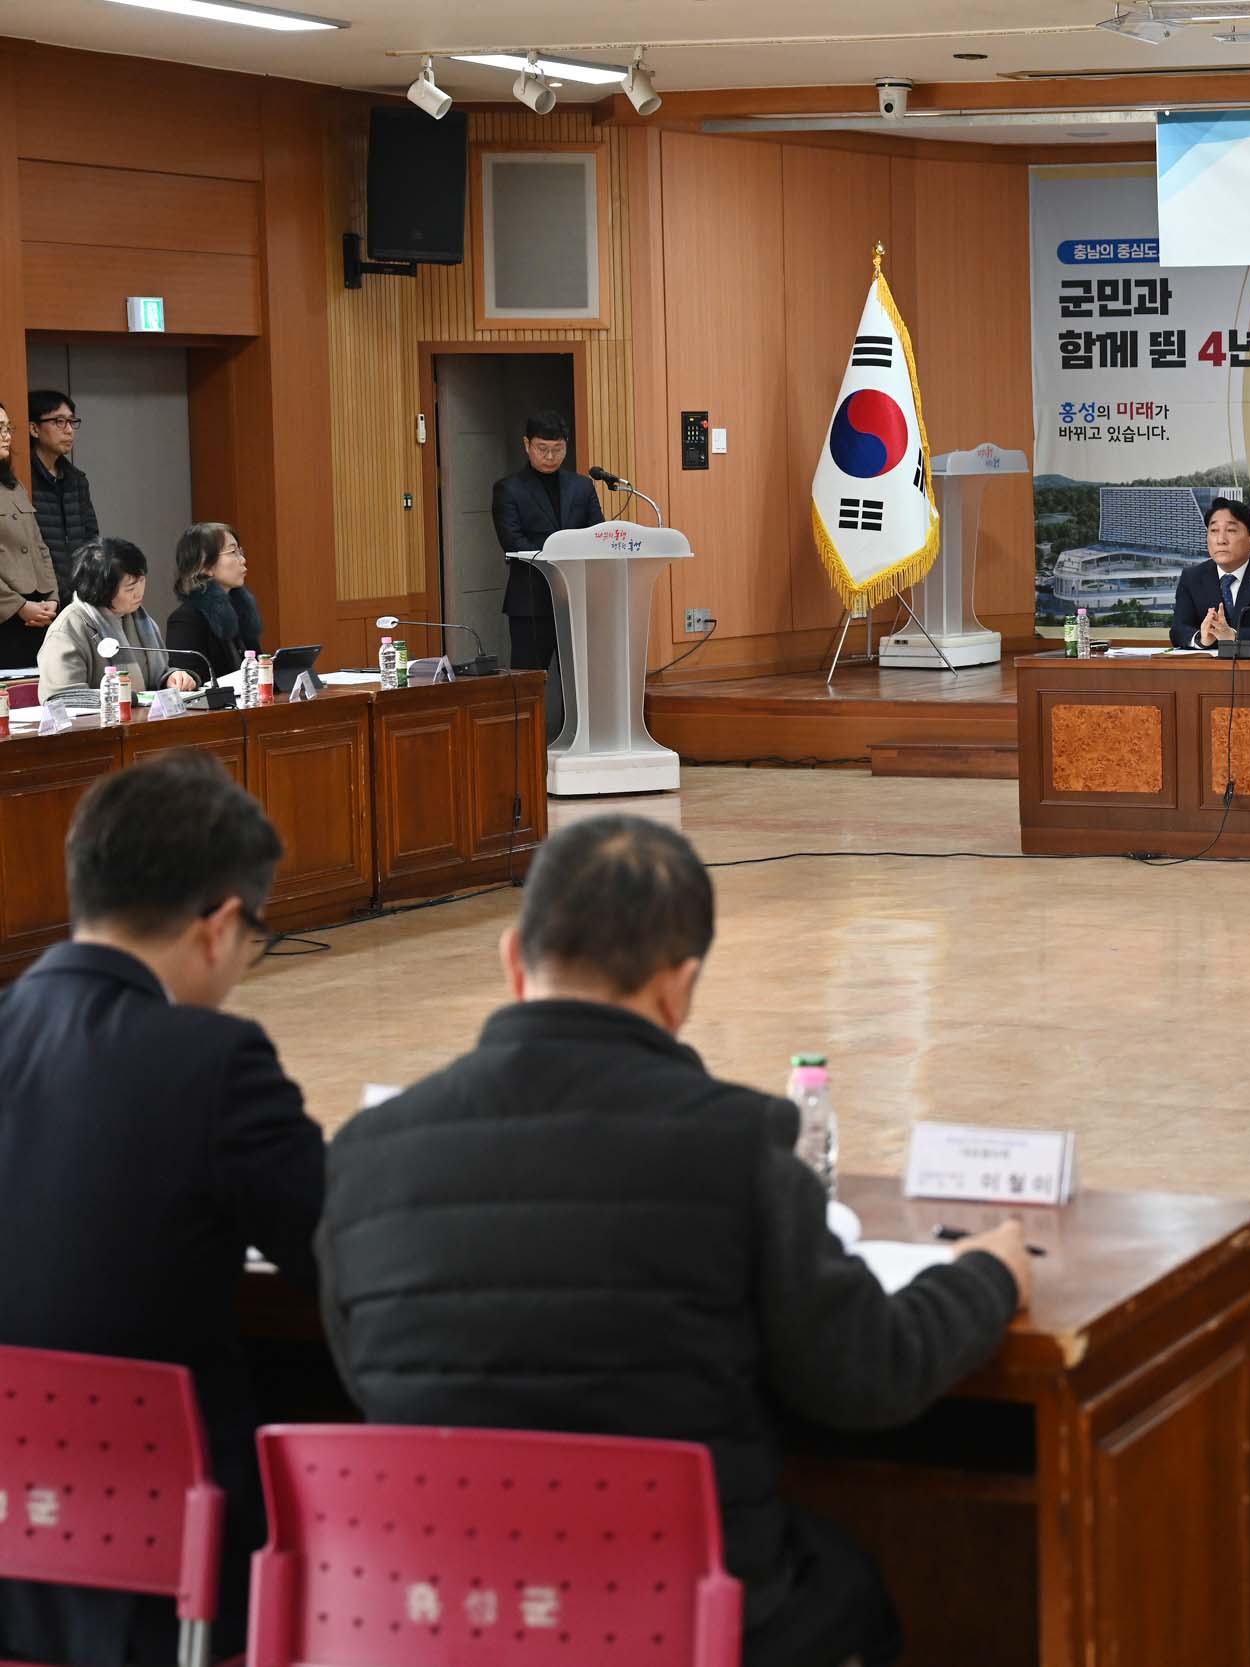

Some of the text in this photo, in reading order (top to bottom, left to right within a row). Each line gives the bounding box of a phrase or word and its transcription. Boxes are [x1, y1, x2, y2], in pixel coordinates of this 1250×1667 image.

[1074, 243, 1160, 260] 충남의 중심도
[1059, 277, 1172, 318] 군민과
[1058, 329, 1138, 369] 함께
[1149, 329, 1186, 368] 뛴
[1058, 401, 1170, 424] 홍성의 미래가
[1059, 425, 1170, 443] 바뀌고 있습니다.
